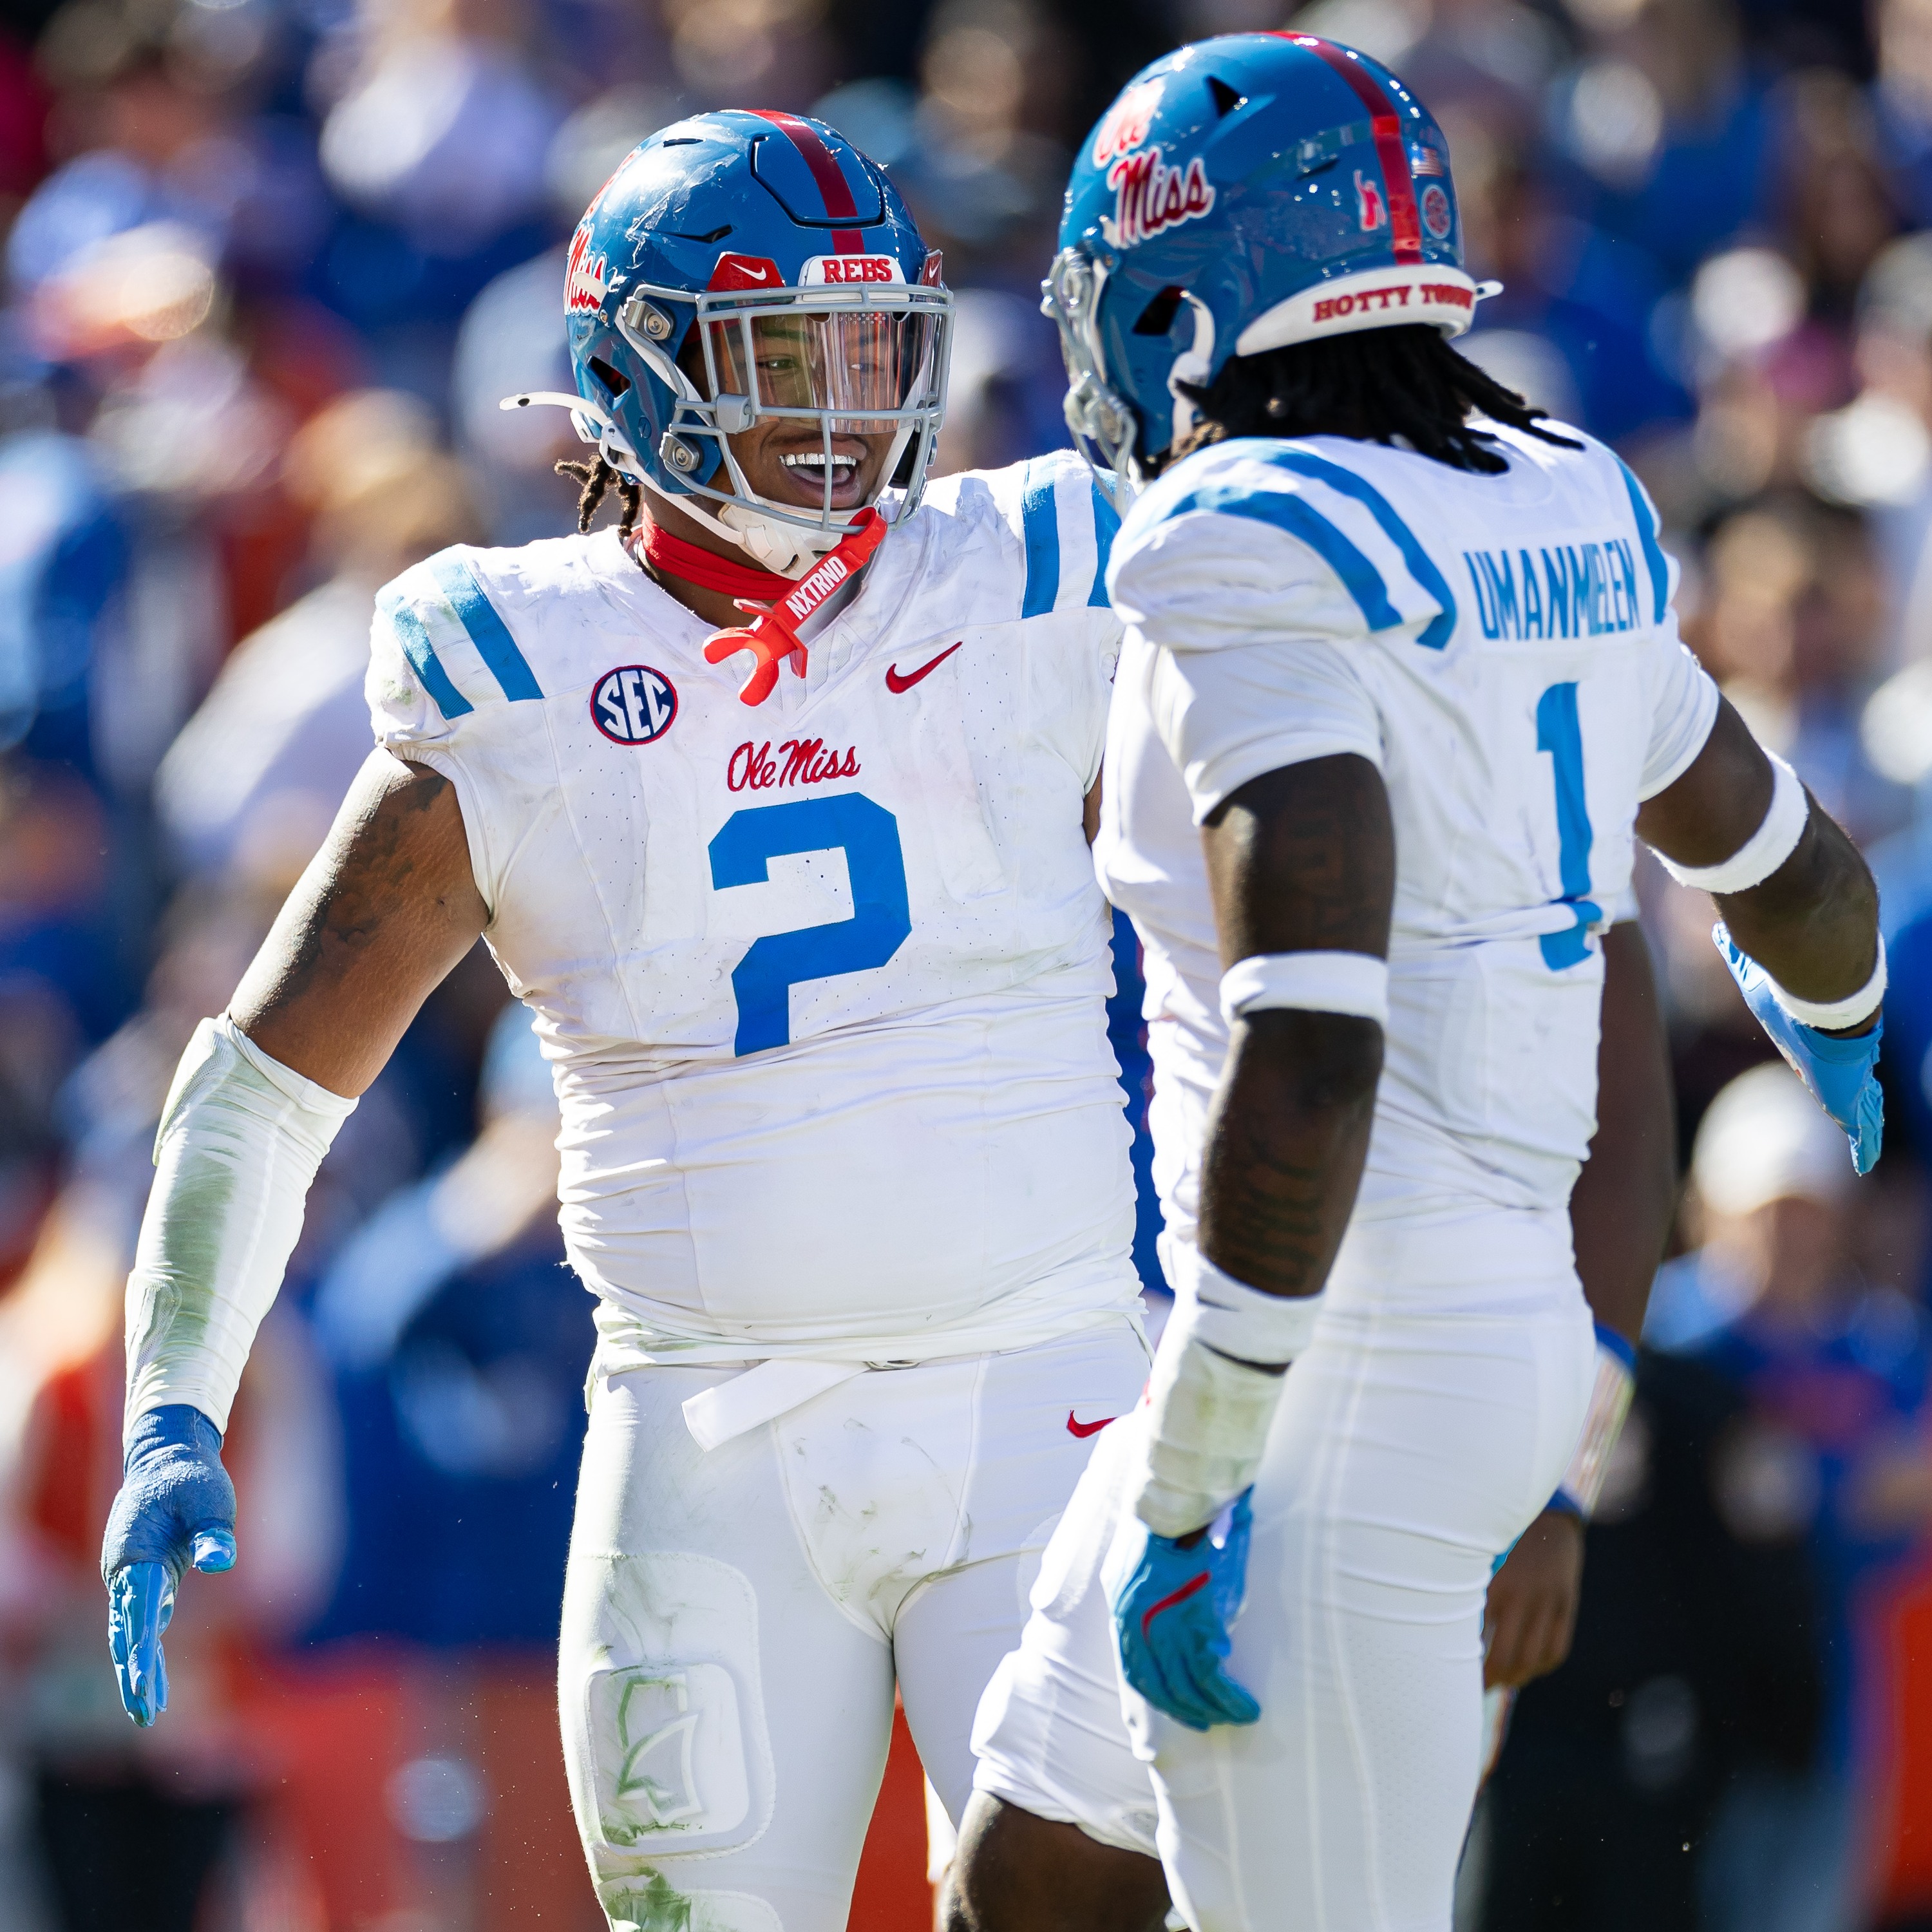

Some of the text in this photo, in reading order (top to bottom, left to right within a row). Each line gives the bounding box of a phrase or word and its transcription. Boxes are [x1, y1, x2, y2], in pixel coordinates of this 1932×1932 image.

[1107, 146, 1215, 249] Miss
[822, 258, 893, 283] REBS
[1312, 285, 1412, 323] HOTTY
[785, 556, 848, 621] NXTRND
[598, 670, 670, 740] SEC
[727, 738, 862, 792] Ole Miss
[1537, 681, 1604, 971] 1
[708, 792, 912, 1057] 2
